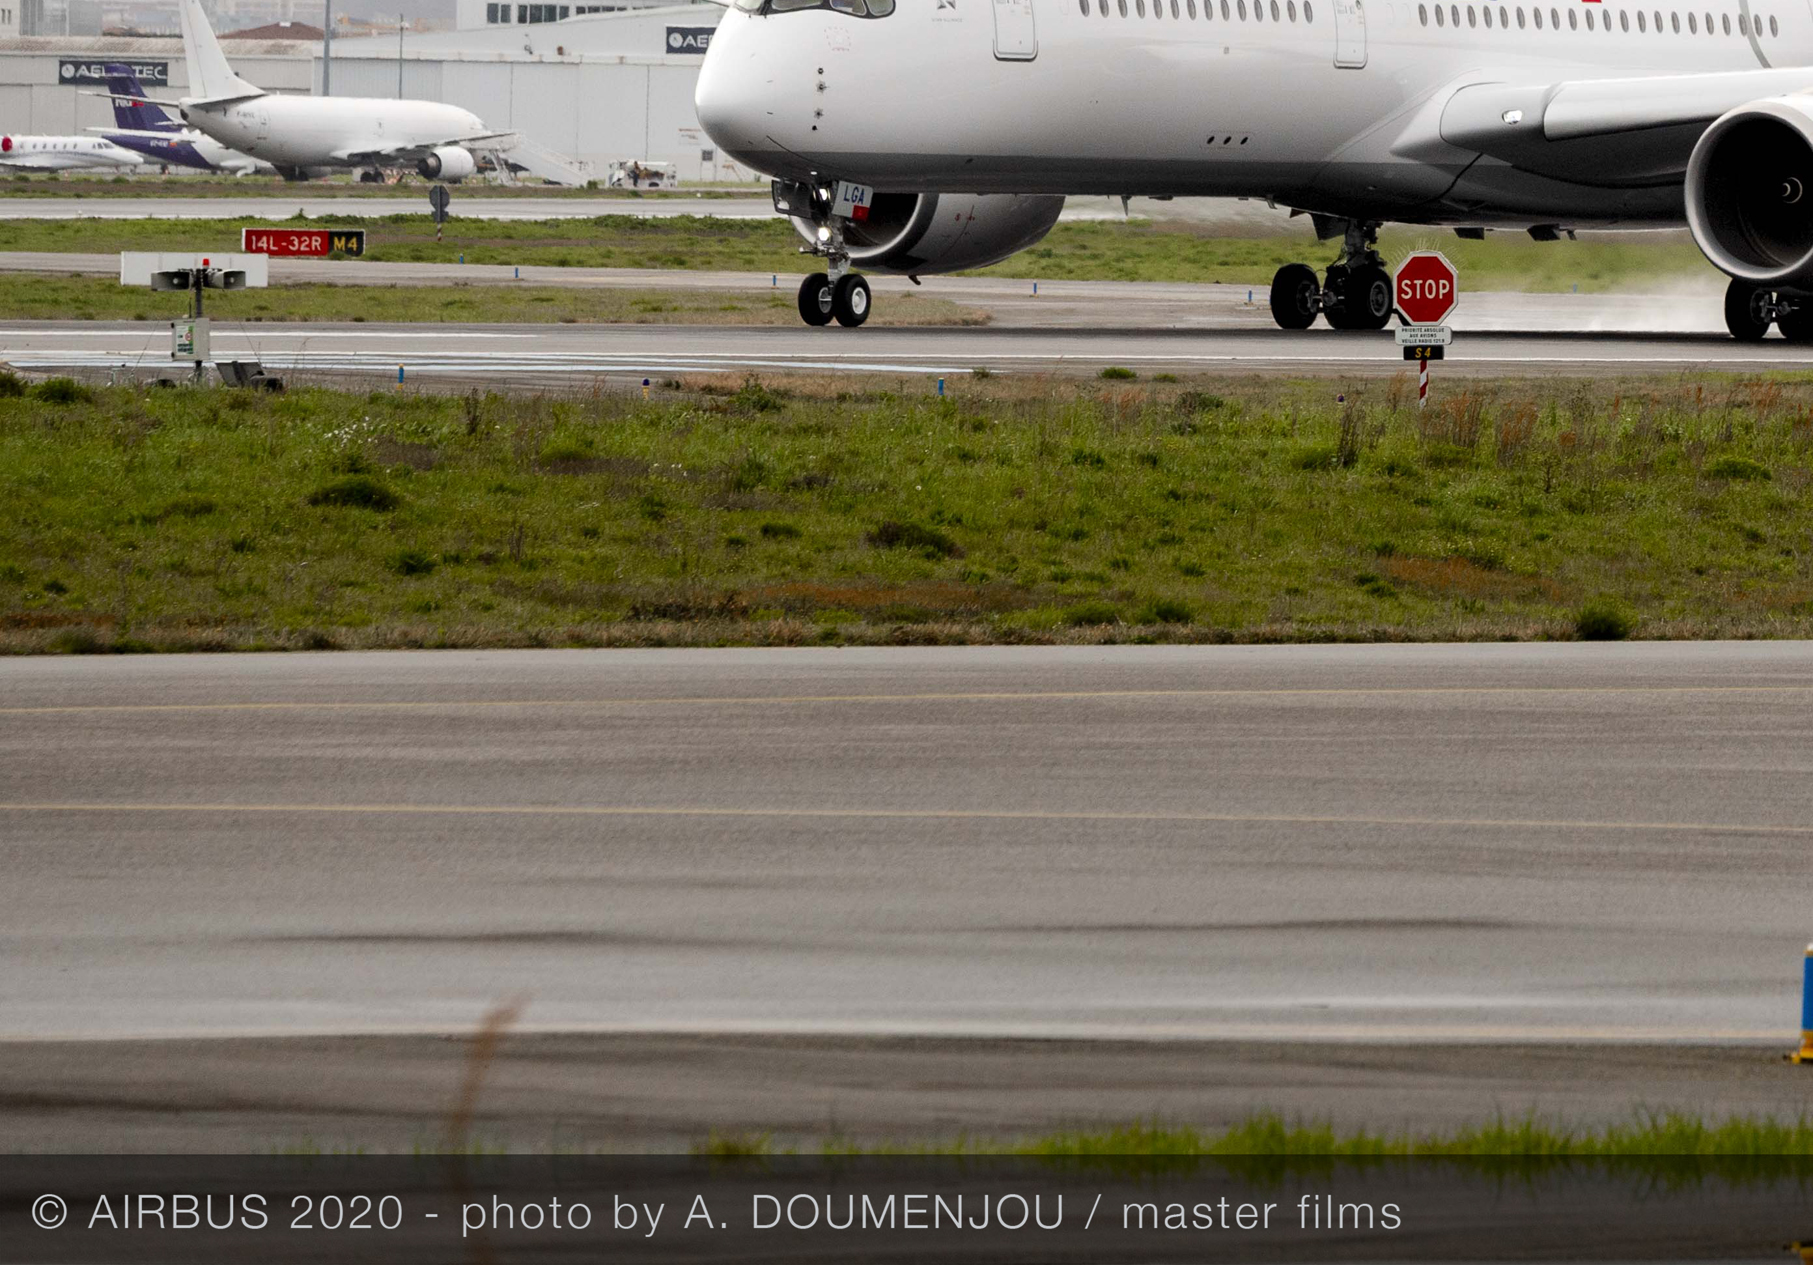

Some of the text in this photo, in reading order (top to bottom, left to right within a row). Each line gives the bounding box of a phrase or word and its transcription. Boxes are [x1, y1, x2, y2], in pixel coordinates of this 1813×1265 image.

[843, 184, 866, 205] LGA
[251, 235, 358, 251] 14L-32R M4
[1401, 279, 1450, 299] STOP
